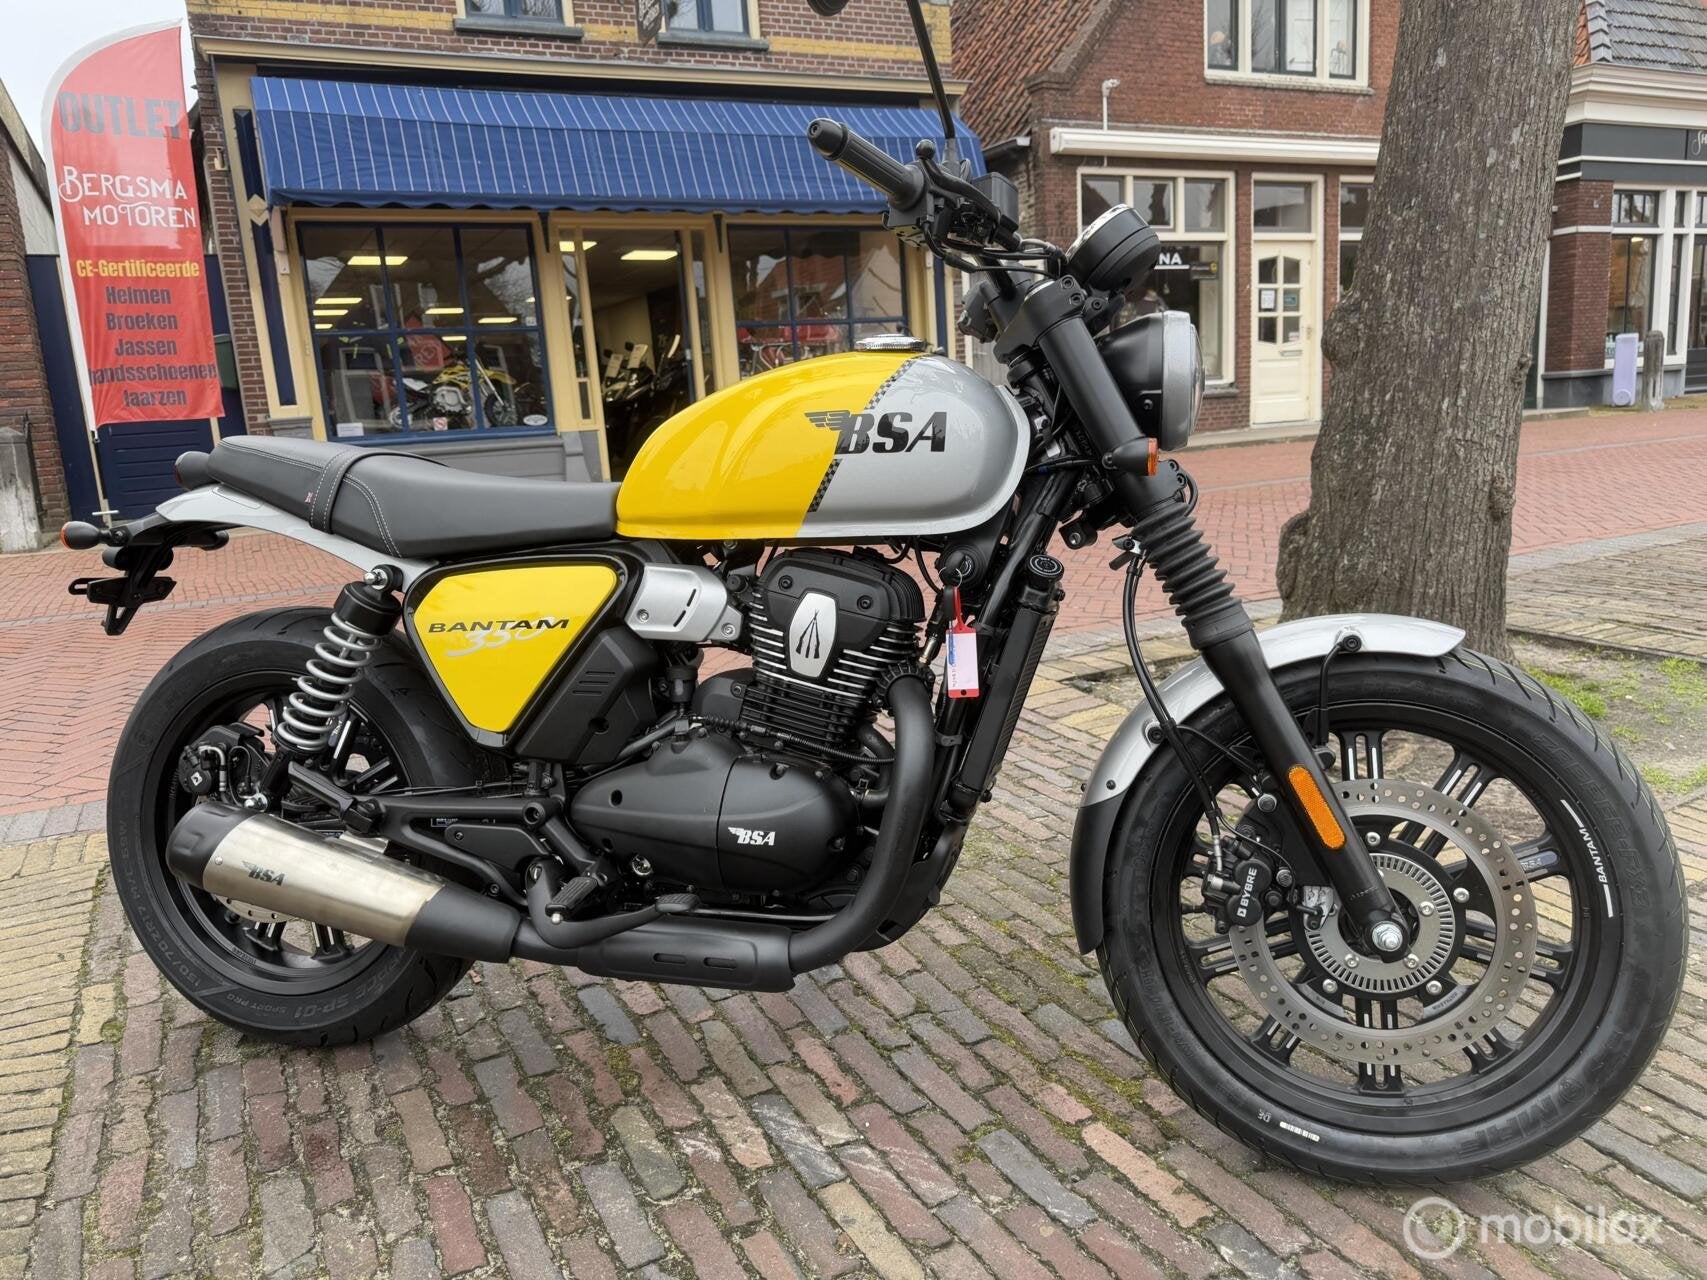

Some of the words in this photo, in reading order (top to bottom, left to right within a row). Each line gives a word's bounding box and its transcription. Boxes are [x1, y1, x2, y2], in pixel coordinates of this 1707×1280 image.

[58, 92, 181, 139] OUTLET
[58, 165, 188, 203] BERGSMA
[83, 201, 197, 228] MOTOREN
[105, 286, 172, 305] Helmen
[105, 313, 179, 331] Broeken
[114, 338, 178, 357] Jassen
[834, 411, 948, 455] BSA
[428, 619, 570, 634] BANTAM
[737, 829, 776, 846] BSA
[1578, 826, 1609, 884] BANTAM
[248, 865, 285, 887] BSA
[1240, 867, 1258, 906] BYBRE
